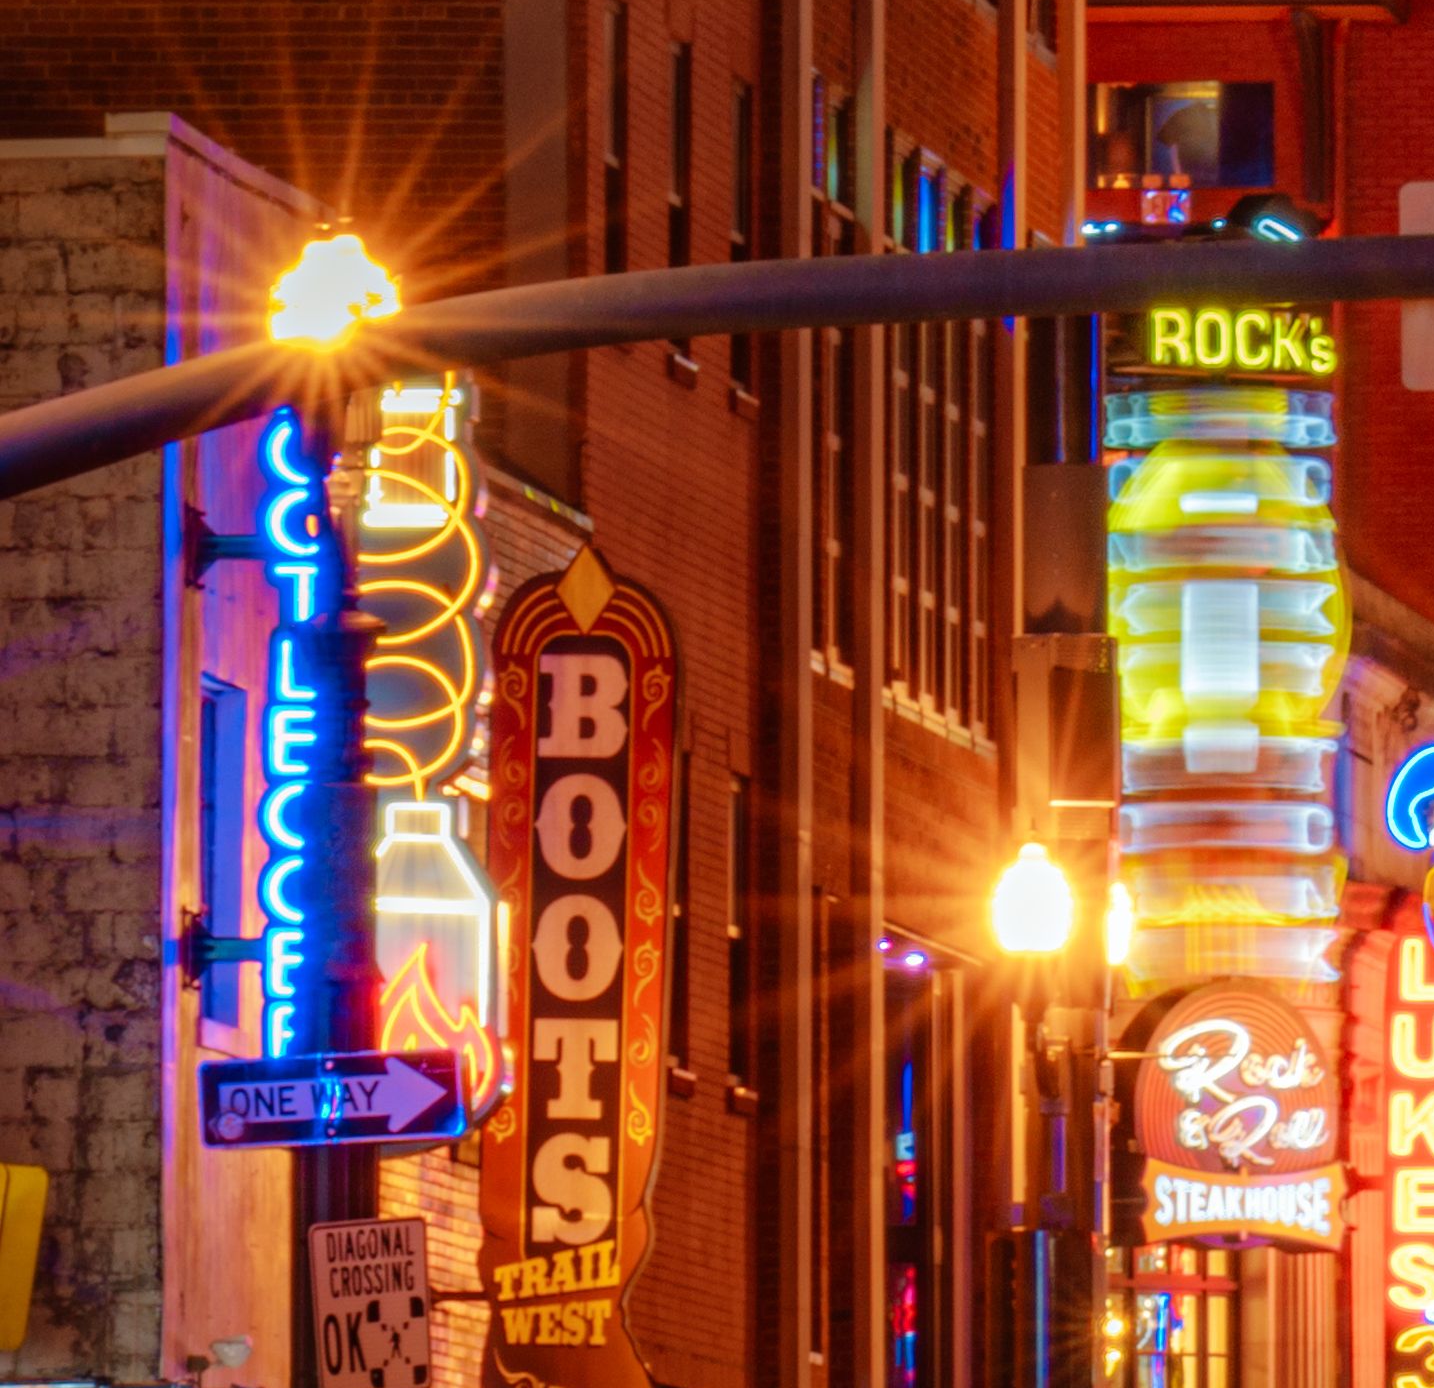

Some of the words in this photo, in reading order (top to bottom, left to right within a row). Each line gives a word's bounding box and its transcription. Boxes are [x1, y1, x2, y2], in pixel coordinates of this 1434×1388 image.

[531, 654, 629, 1246] BOOTS
[1158, 1017, 1325, 1104] Rock
[228, 1085, 297, 1120] ONE
[308, 1078, 382, 1116] WAY
[1154, 1174, 1331, 1237] STEAKHOUSE
[325, 1224, 415, 1260] DIAGONAL
[494, 1241, 621, 1301] TRAIL
[329, 1261, 415, 1298] CROSSING
[322, 1311, 367, 1375] OK
[501, 1301, 612, 1346] WEST
